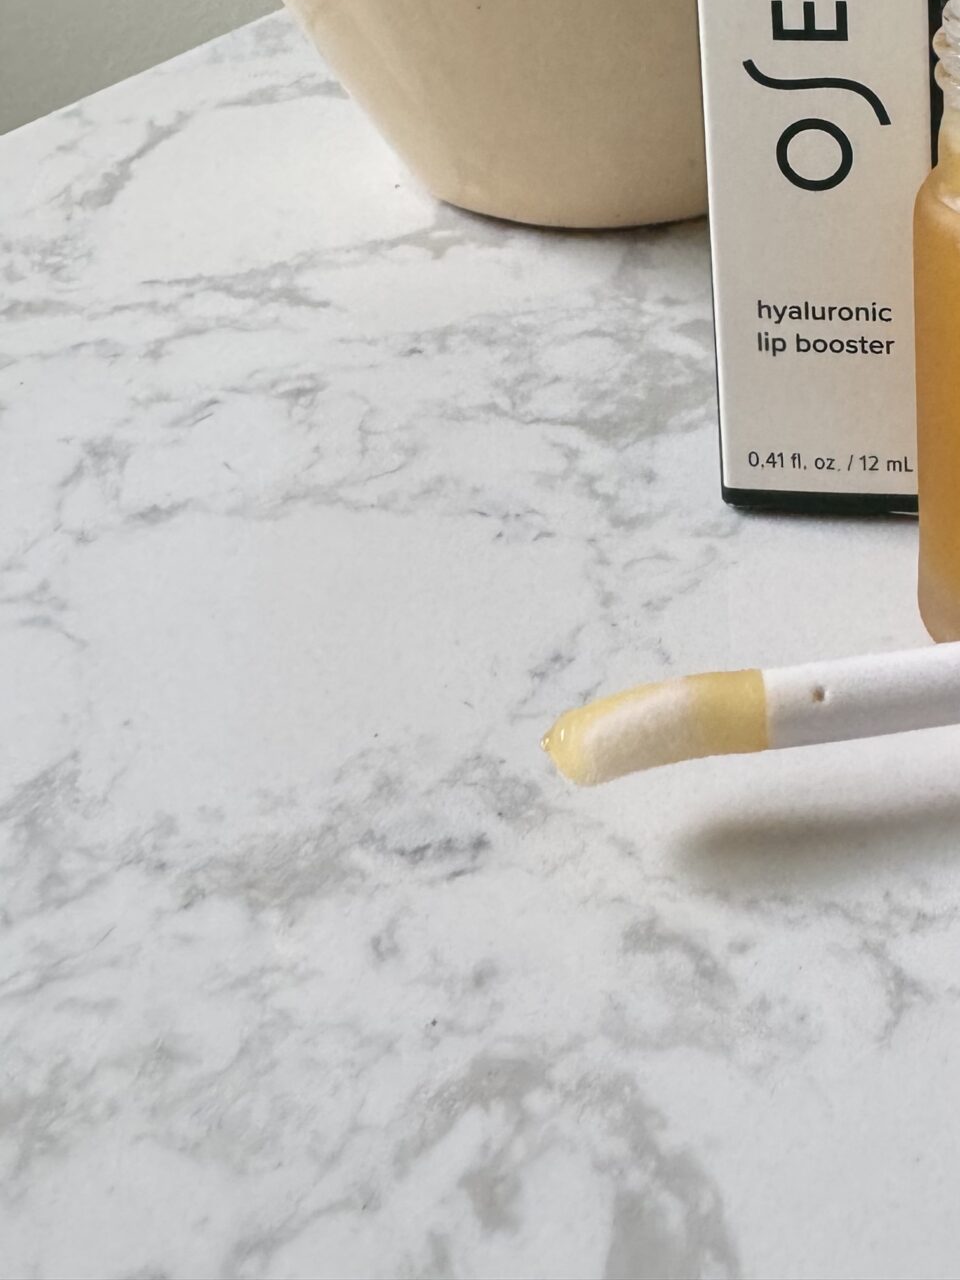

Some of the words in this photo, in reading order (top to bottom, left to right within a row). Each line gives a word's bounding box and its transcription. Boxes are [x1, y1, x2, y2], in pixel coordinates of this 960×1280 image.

[757, 299, 893, 325] hyaluronic
[757, 331, 787, 357] lip
[795, 332, 896, 355] booster
[748, 451, 785, 469] 0.41
[790, 452, 807, 470] fl.
[814, 456, 841, 472] oz.
[847, 454, 854, 472] /
[858, 454, 880, 472] 12
[886, 455, 914, 473] mL
